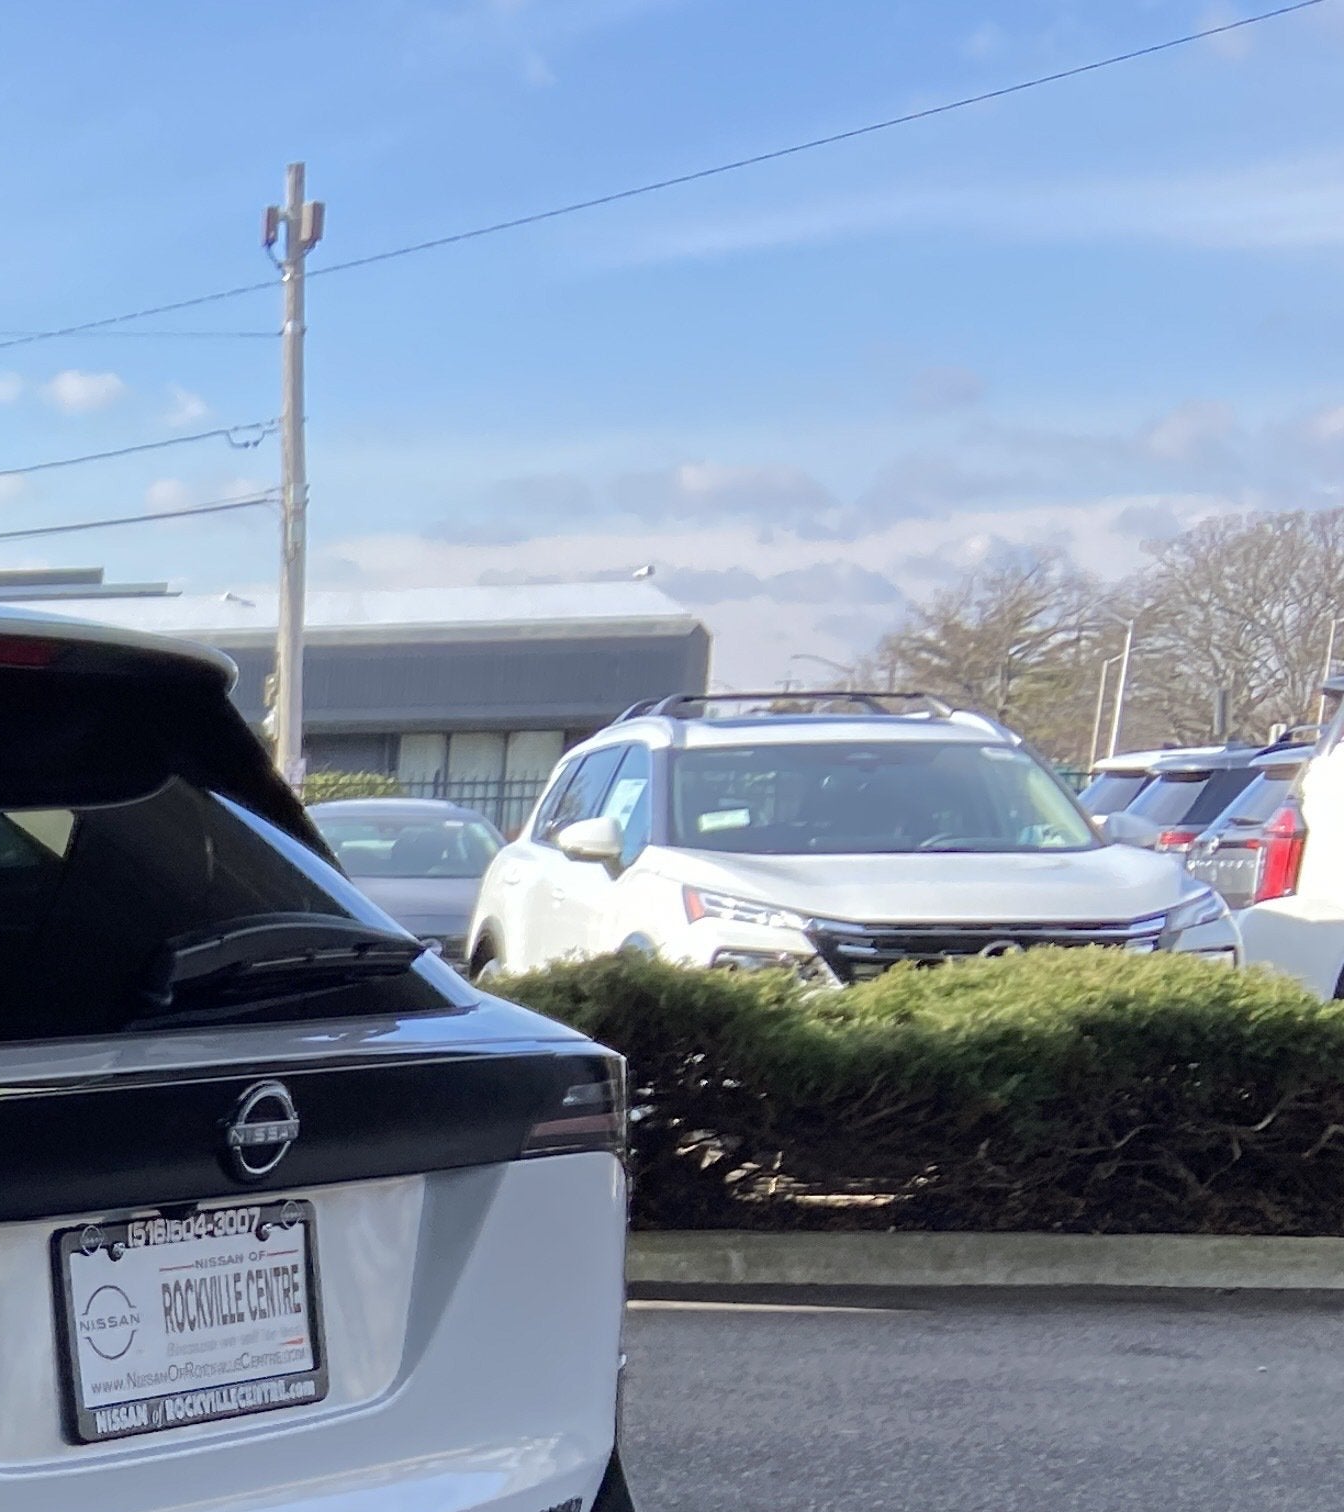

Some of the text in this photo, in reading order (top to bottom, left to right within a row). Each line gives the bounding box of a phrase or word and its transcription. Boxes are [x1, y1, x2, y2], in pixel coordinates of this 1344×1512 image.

[230, 1122, 298, 1144] NISSAN
[194, 1250, 266, 1269] NISSAN OF
[161, 1263, 302, 1333] ROCKVILLE CENTRE
[79, 1312, 140, 1332] NISSAN
[94, 1403, 148, 1434] NISSAN
